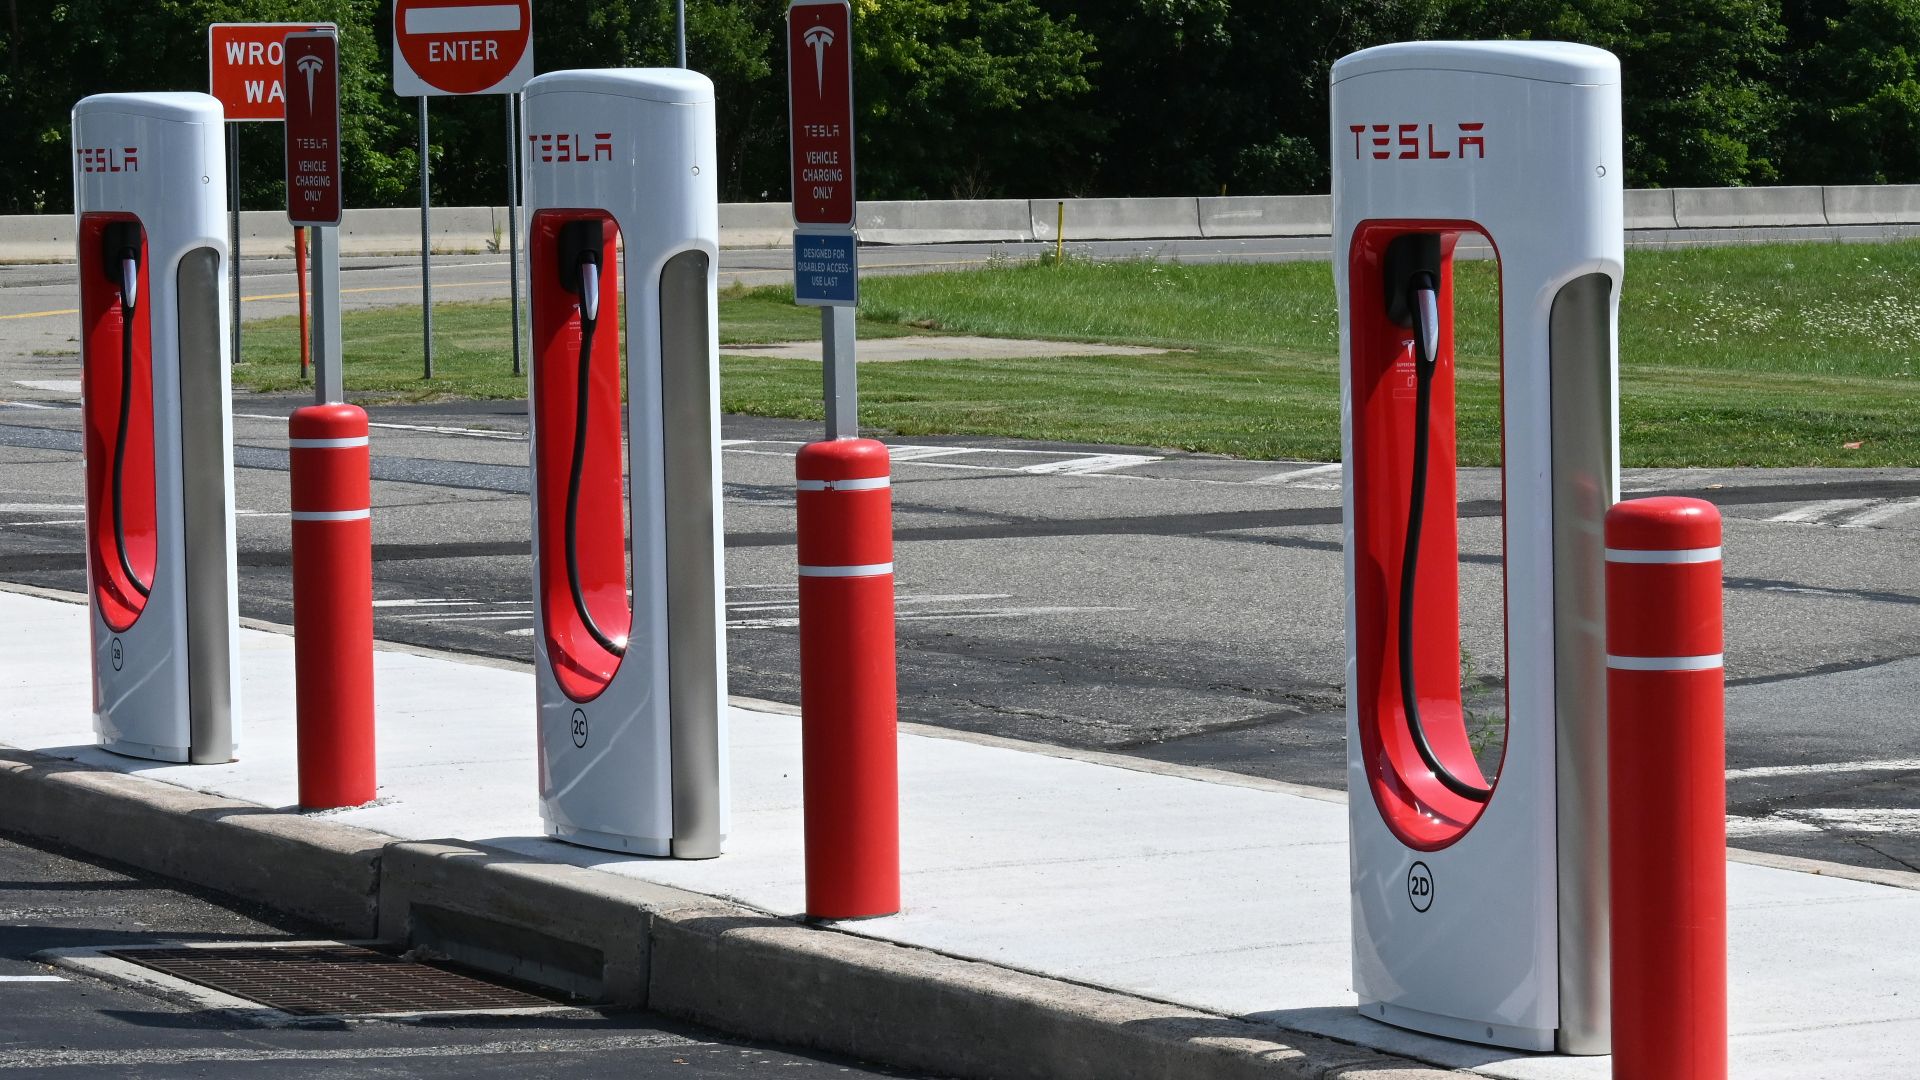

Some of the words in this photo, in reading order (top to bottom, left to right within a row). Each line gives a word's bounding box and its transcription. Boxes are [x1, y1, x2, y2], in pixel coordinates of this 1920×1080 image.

[225, 41, 284, 65] WRO
[429, 40, 499, 62] ENTER
[244, 80, 285, 103] WA
[804, 125, 840, 137] TESLA
[297, 138, 328, 149] TESLA
[529, 133, 612, 162] TESLA
[1350, 123, 1484, 159] TESLA
[77, 147, 138, 172] TESLA
[806, 152, 838, 165] VEHICLE
[298, 160, 327, 172] VEHICLE
[295, 175, 331, 187] CHARGING
[802, 169, 843, 182] CHARGING
[304, 190, 322, 201] ONLY
[813, 186, 833, 199] ONLY
[803, 248, 832, 259] DESIGNED
[833, 249, 845, 259] FOR
[797, 261, 826, 272] DISABLED
[811, 276, 823, 287] USE
[823, 276, 838, 287] LAST
[573, 719, 585, 736] 2C
[1411, 876, 1430, 896] 2D
